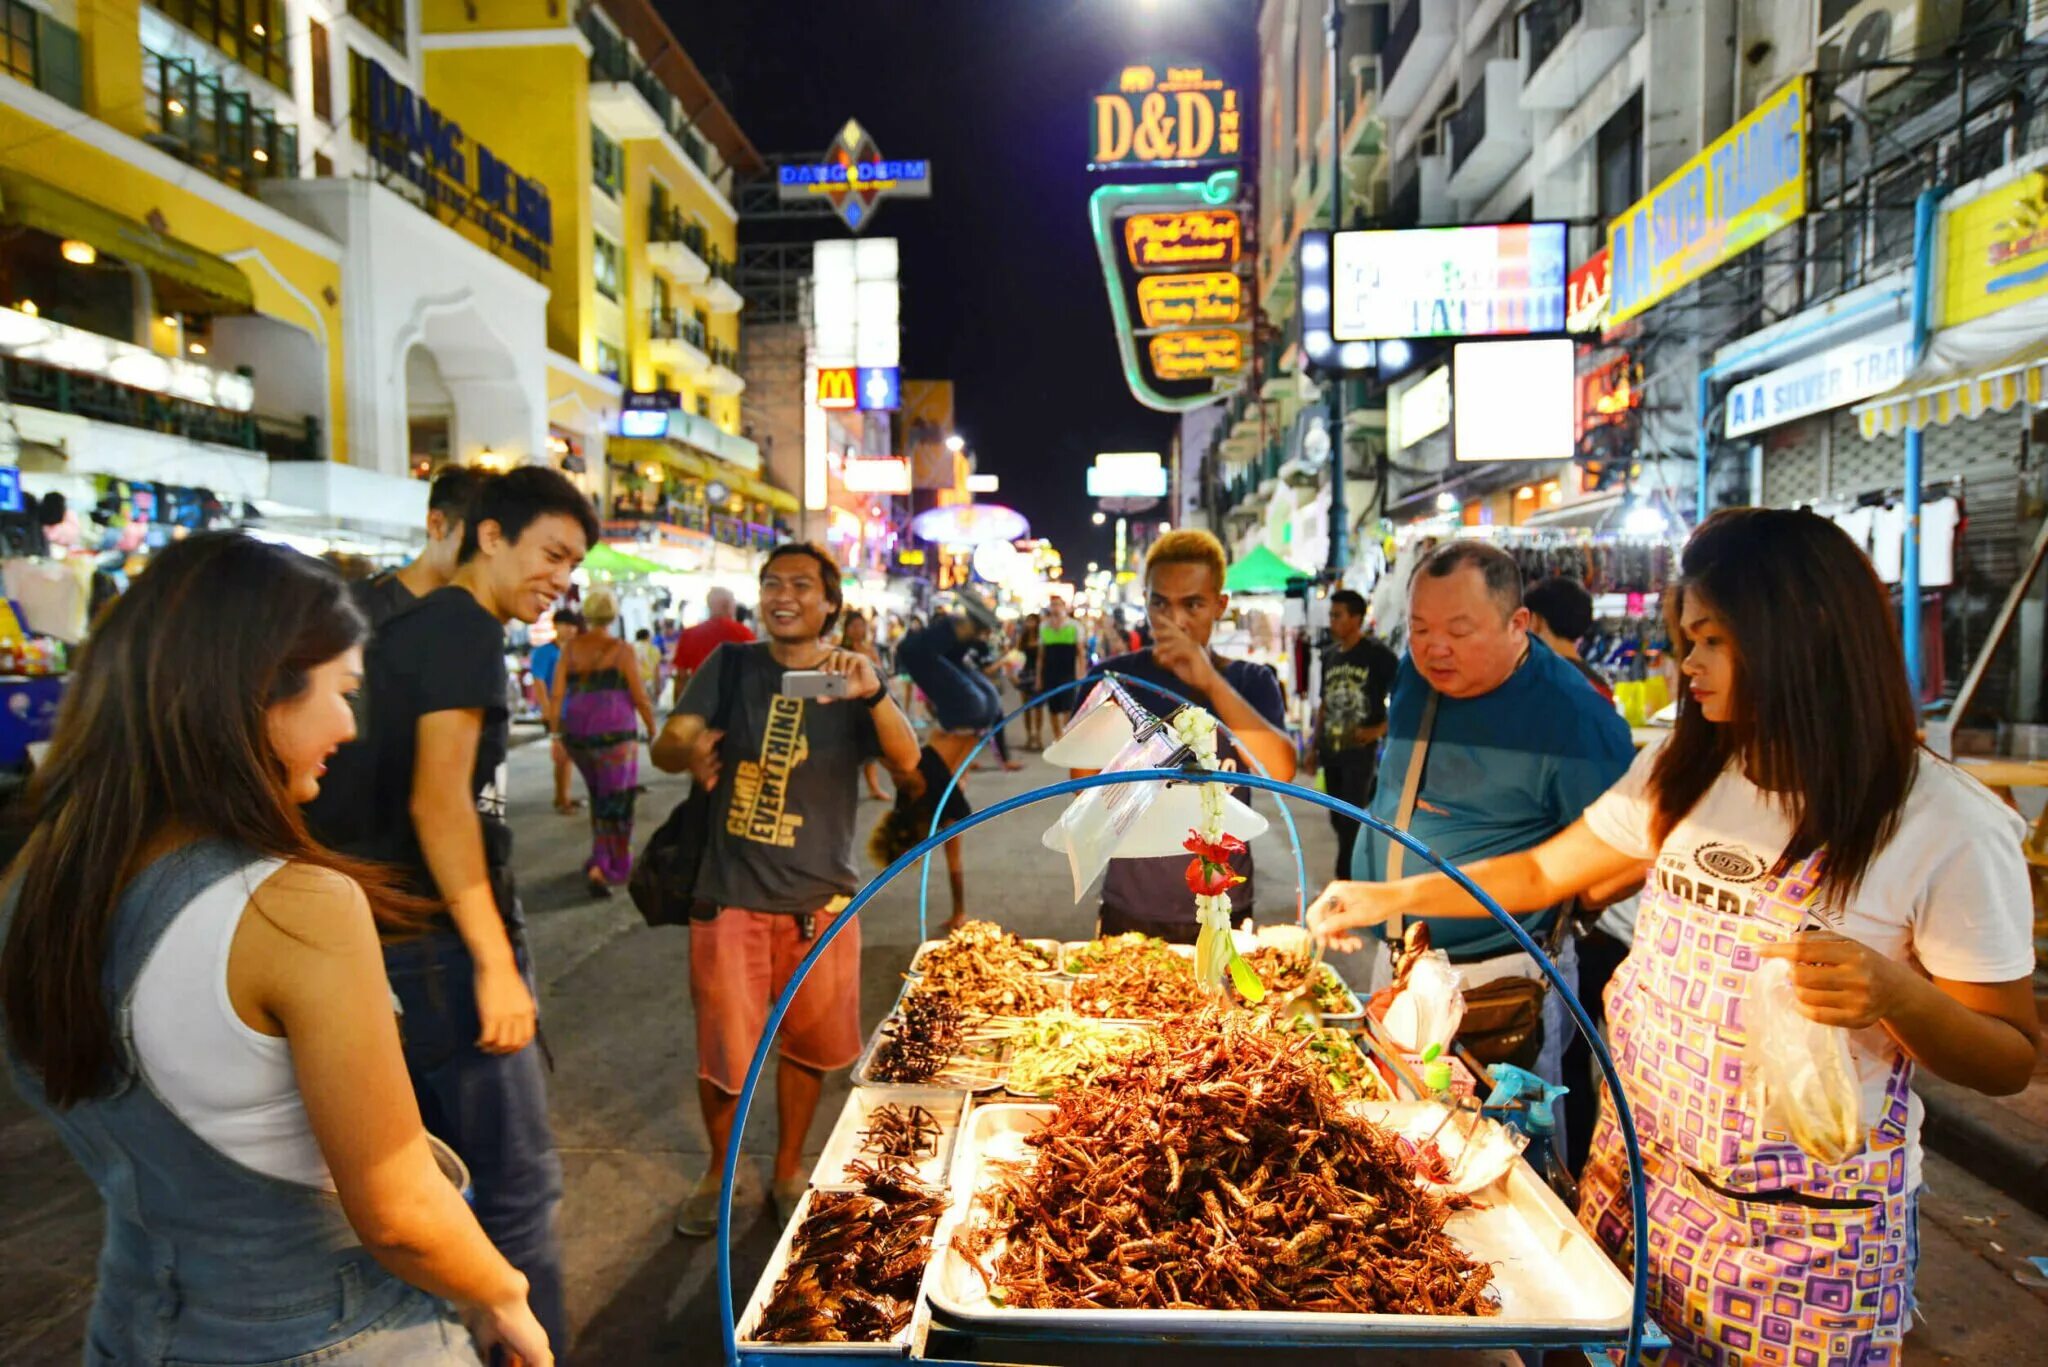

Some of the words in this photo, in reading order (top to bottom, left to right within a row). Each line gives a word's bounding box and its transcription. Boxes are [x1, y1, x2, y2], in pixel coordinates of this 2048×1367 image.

[1094, 91, 1215, 163] D&D
[1610, 208, 1650, 316] AA
[1652, 163, 1707, 268] SILVER
[1711, 92, 1800, 229] TRADING
[1774, 367, 1842, 415] SILVER
[726, 760, 761, 837] CLIMB
[750, 697, 799, 838] EVERYTHING
